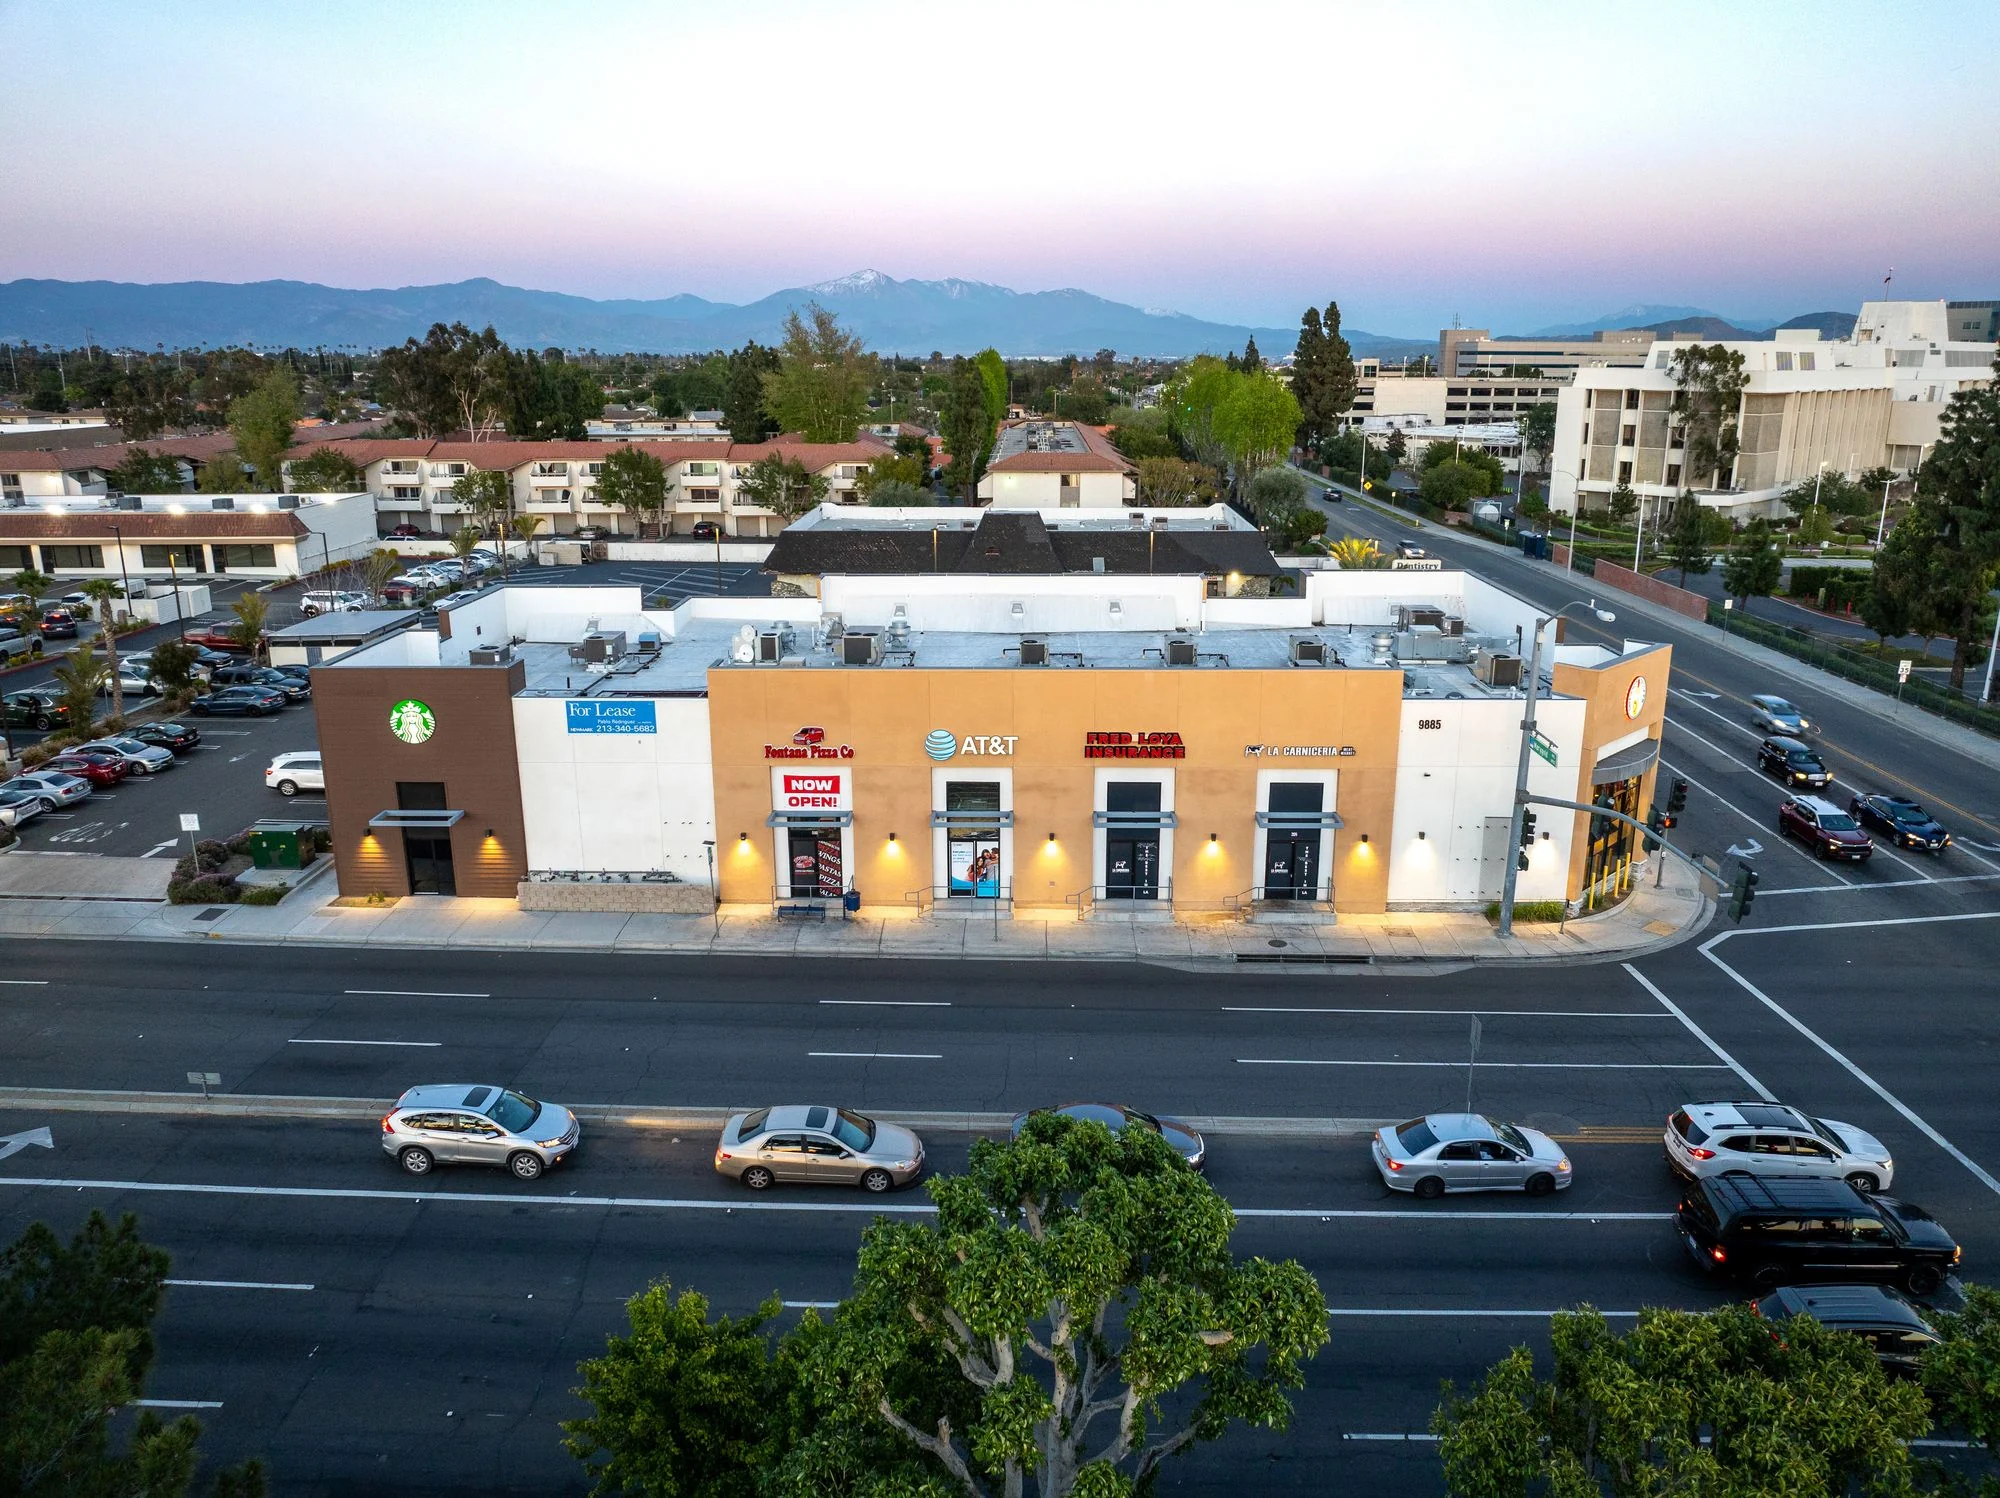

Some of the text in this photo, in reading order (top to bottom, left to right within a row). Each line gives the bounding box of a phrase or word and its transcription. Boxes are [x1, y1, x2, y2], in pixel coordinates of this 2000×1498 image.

[1397, 562, 1438, 570] Dentistry
[568, 702, 636, 717] For Lease
[1418, 719, 1442, 730] 9885
[1087, 732, 1183, 745] FRED LOYA
[960, 735, 1019, 755] AT&T
[1267, 746, 1337, 756] LA CARNICERIA
[764, 744, 854, 759] Fontana Pizza Co
[1085, 746, 1185, 759] INSURANCE
[791, 780, 832, 790] NOW
[788, 796, 837, 807] OPEN!
